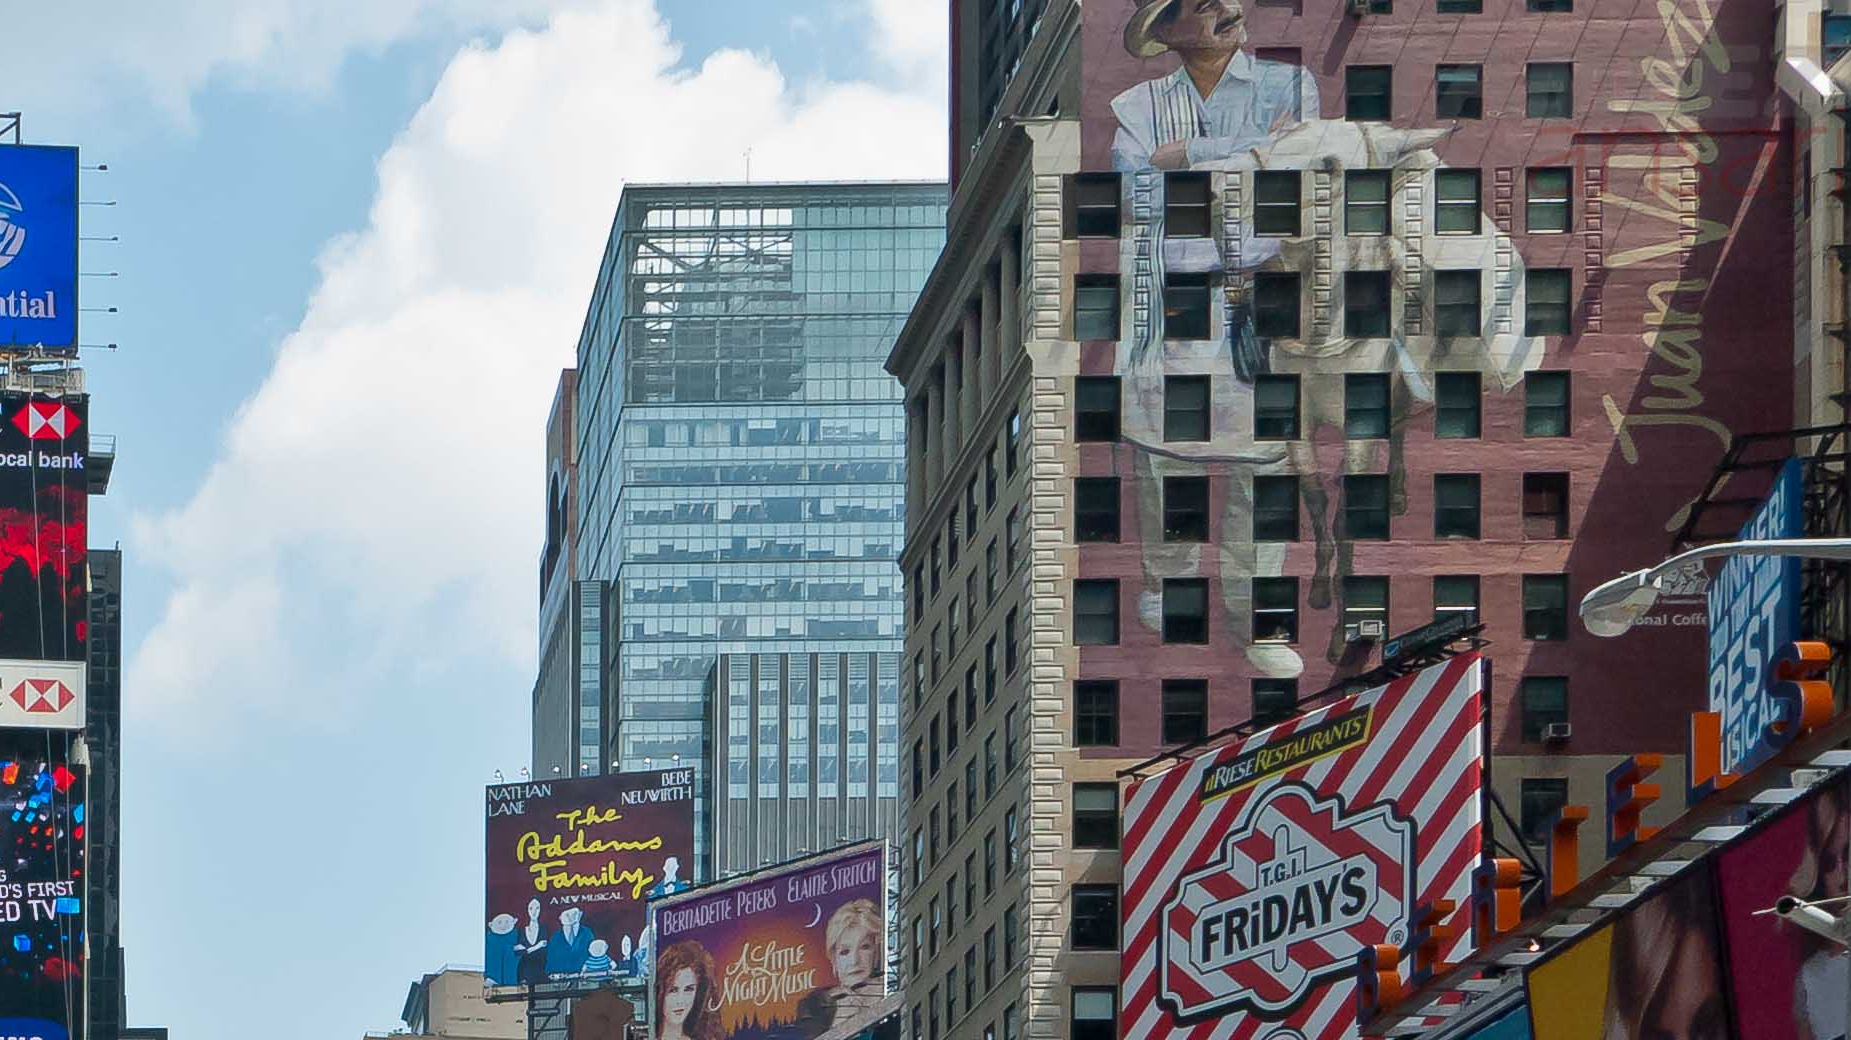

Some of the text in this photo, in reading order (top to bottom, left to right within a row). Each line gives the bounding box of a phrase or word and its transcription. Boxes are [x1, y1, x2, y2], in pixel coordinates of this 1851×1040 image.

[1603, 279, 1731, 464] Juan
[37, 452, 85, 471] bank
[1628, 613, 1667, 626] onal
[1709, 580, 1782, 732] BEST
[1214, 714, 1365, 792] RIESE RESTAURANTS
[488, 783, 552, 801] NATHAN
[661, 770, 692, 787] BEBE
[488, 801, 525, 817] LANE
[621, 785, 692, 806] NEUWIRTH
[555, 805, 623, 831] The
[516, 829, 663, 863] Addams
[529, 860, 655, 900] Family
[1260, 859, 1303, 889] T.G.I.
[27, 881, 75, 898] FIRST
[663, 860, 877, 936] BERNADETTE PETERS ELAINE STRITCH
[28, 899, 57, 921] TV
[751, 941, 805, 970] LITTLE
[708, 966, 818, 1012] NIGHT MUSIC
